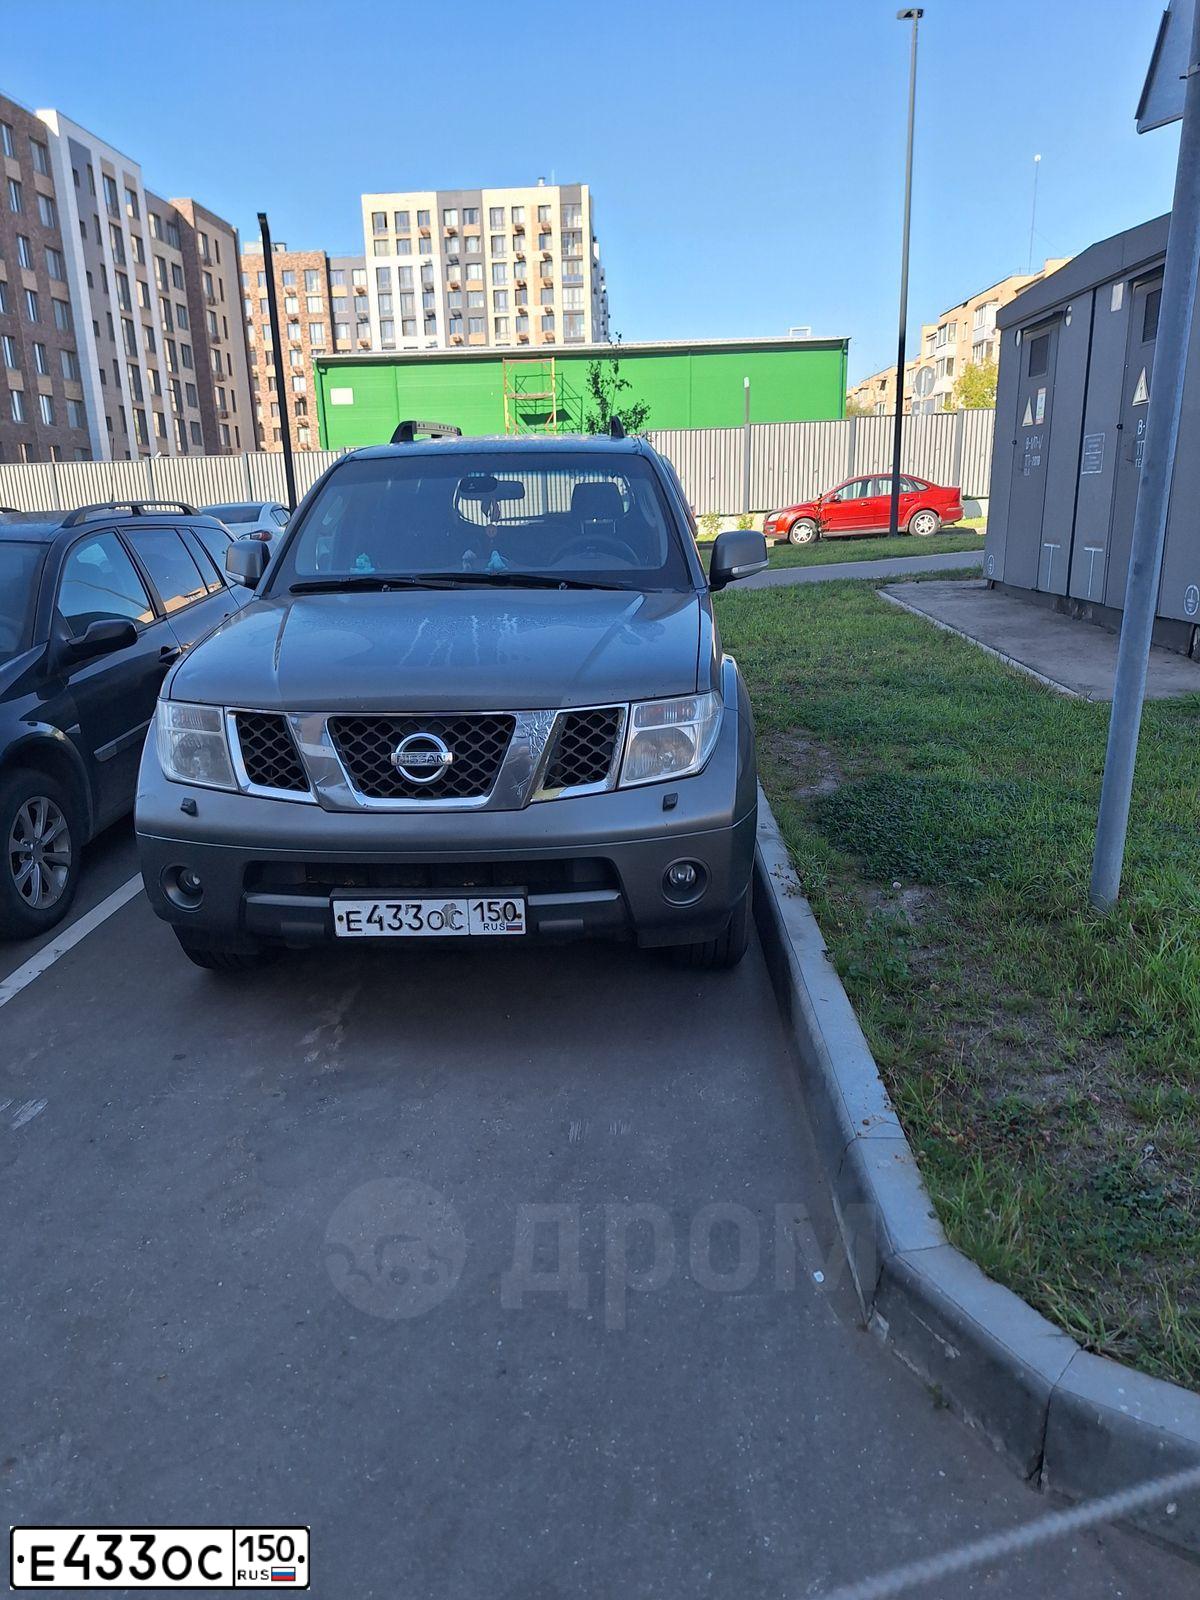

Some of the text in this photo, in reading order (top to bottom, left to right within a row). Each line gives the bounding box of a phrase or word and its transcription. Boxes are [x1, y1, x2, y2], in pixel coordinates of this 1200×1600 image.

[396, 754, 446, 763] NISSAN
[472, 901, 517, 922] 150
[483, 923, 506, 931] RUS
